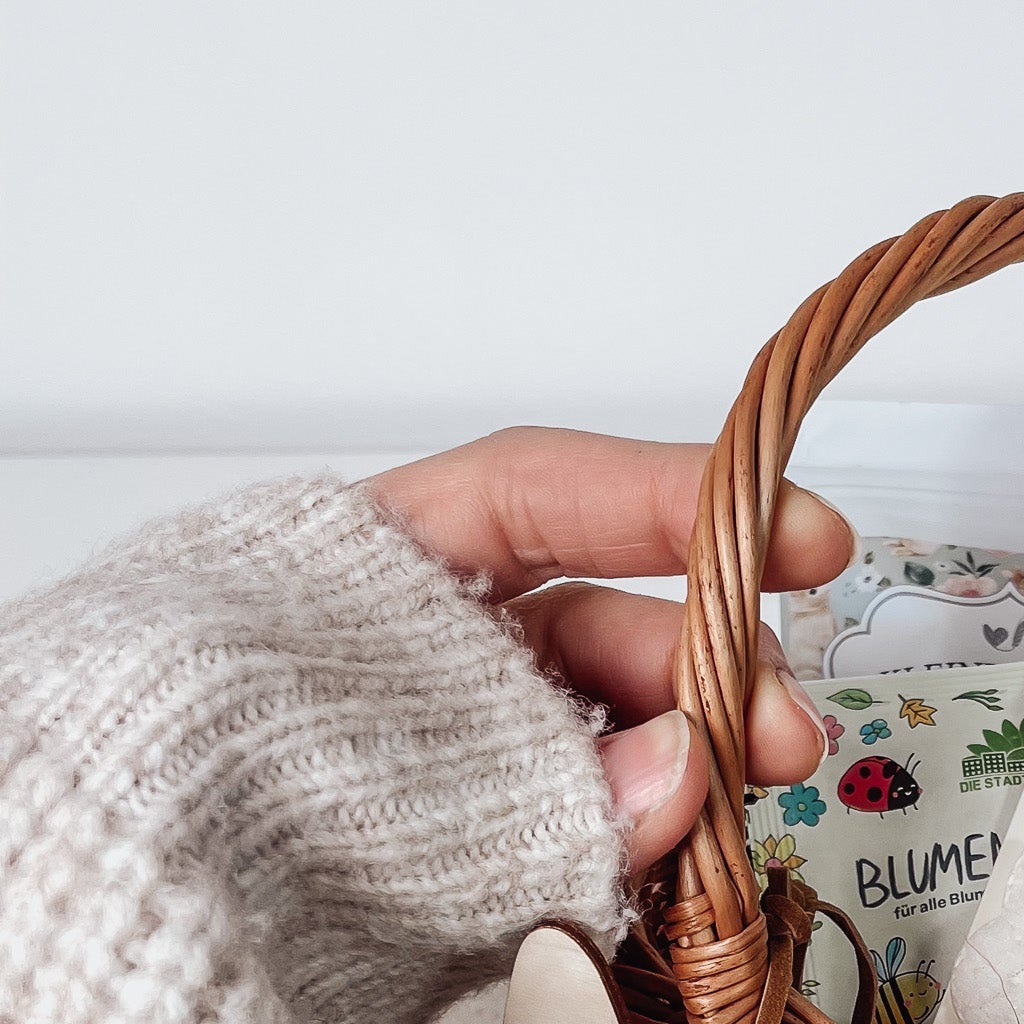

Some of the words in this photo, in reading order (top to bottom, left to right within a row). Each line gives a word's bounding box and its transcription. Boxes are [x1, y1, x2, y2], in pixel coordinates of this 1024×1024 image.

[959, 779, 981, 794] DIE
[894, 904, 918, 919] für
[919, 898, 947, 913] alle
